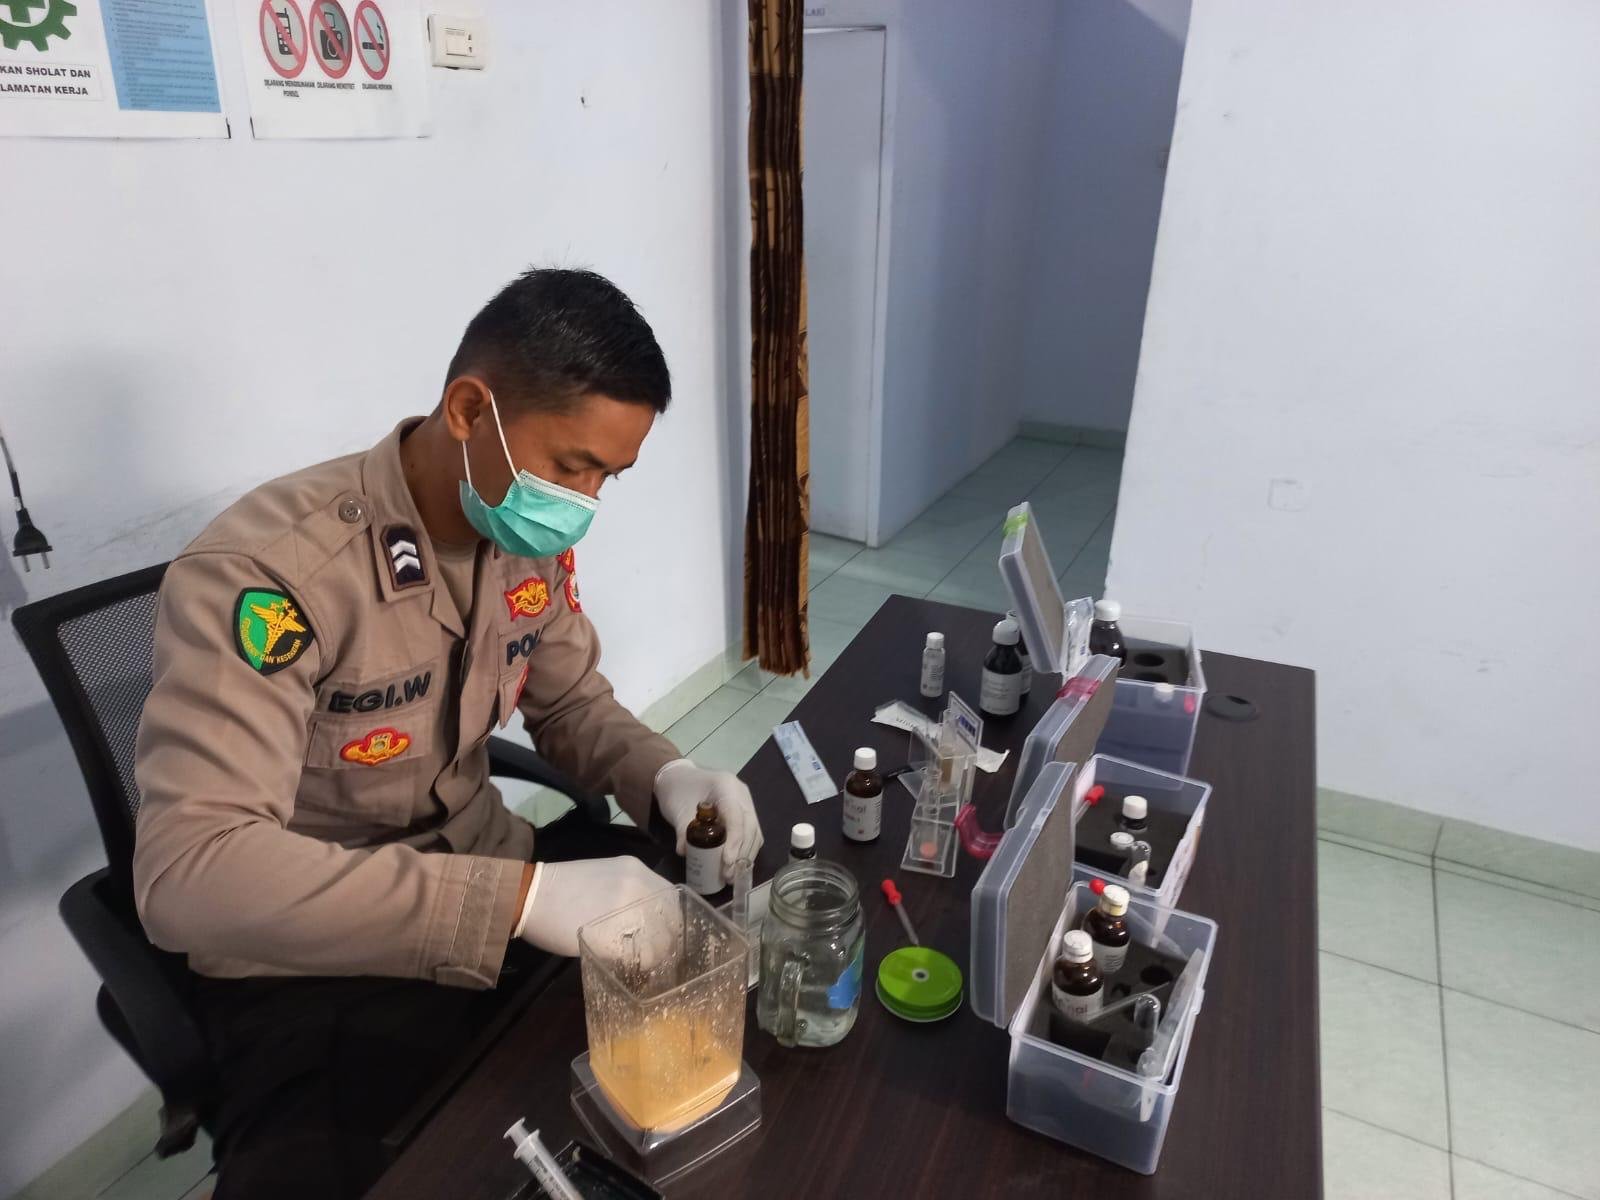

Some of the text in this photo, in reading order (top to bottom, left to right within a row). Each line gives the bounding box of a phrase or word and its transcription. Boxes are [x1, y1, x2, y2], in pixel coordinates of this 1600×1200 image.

[26, 67, 67, 77] SHOLAT
[70, 69, 91, 78] DAN
[0, 83, 88, 96] LAMATAN KERJA
[328, 671, 431, 713] EGI.W
